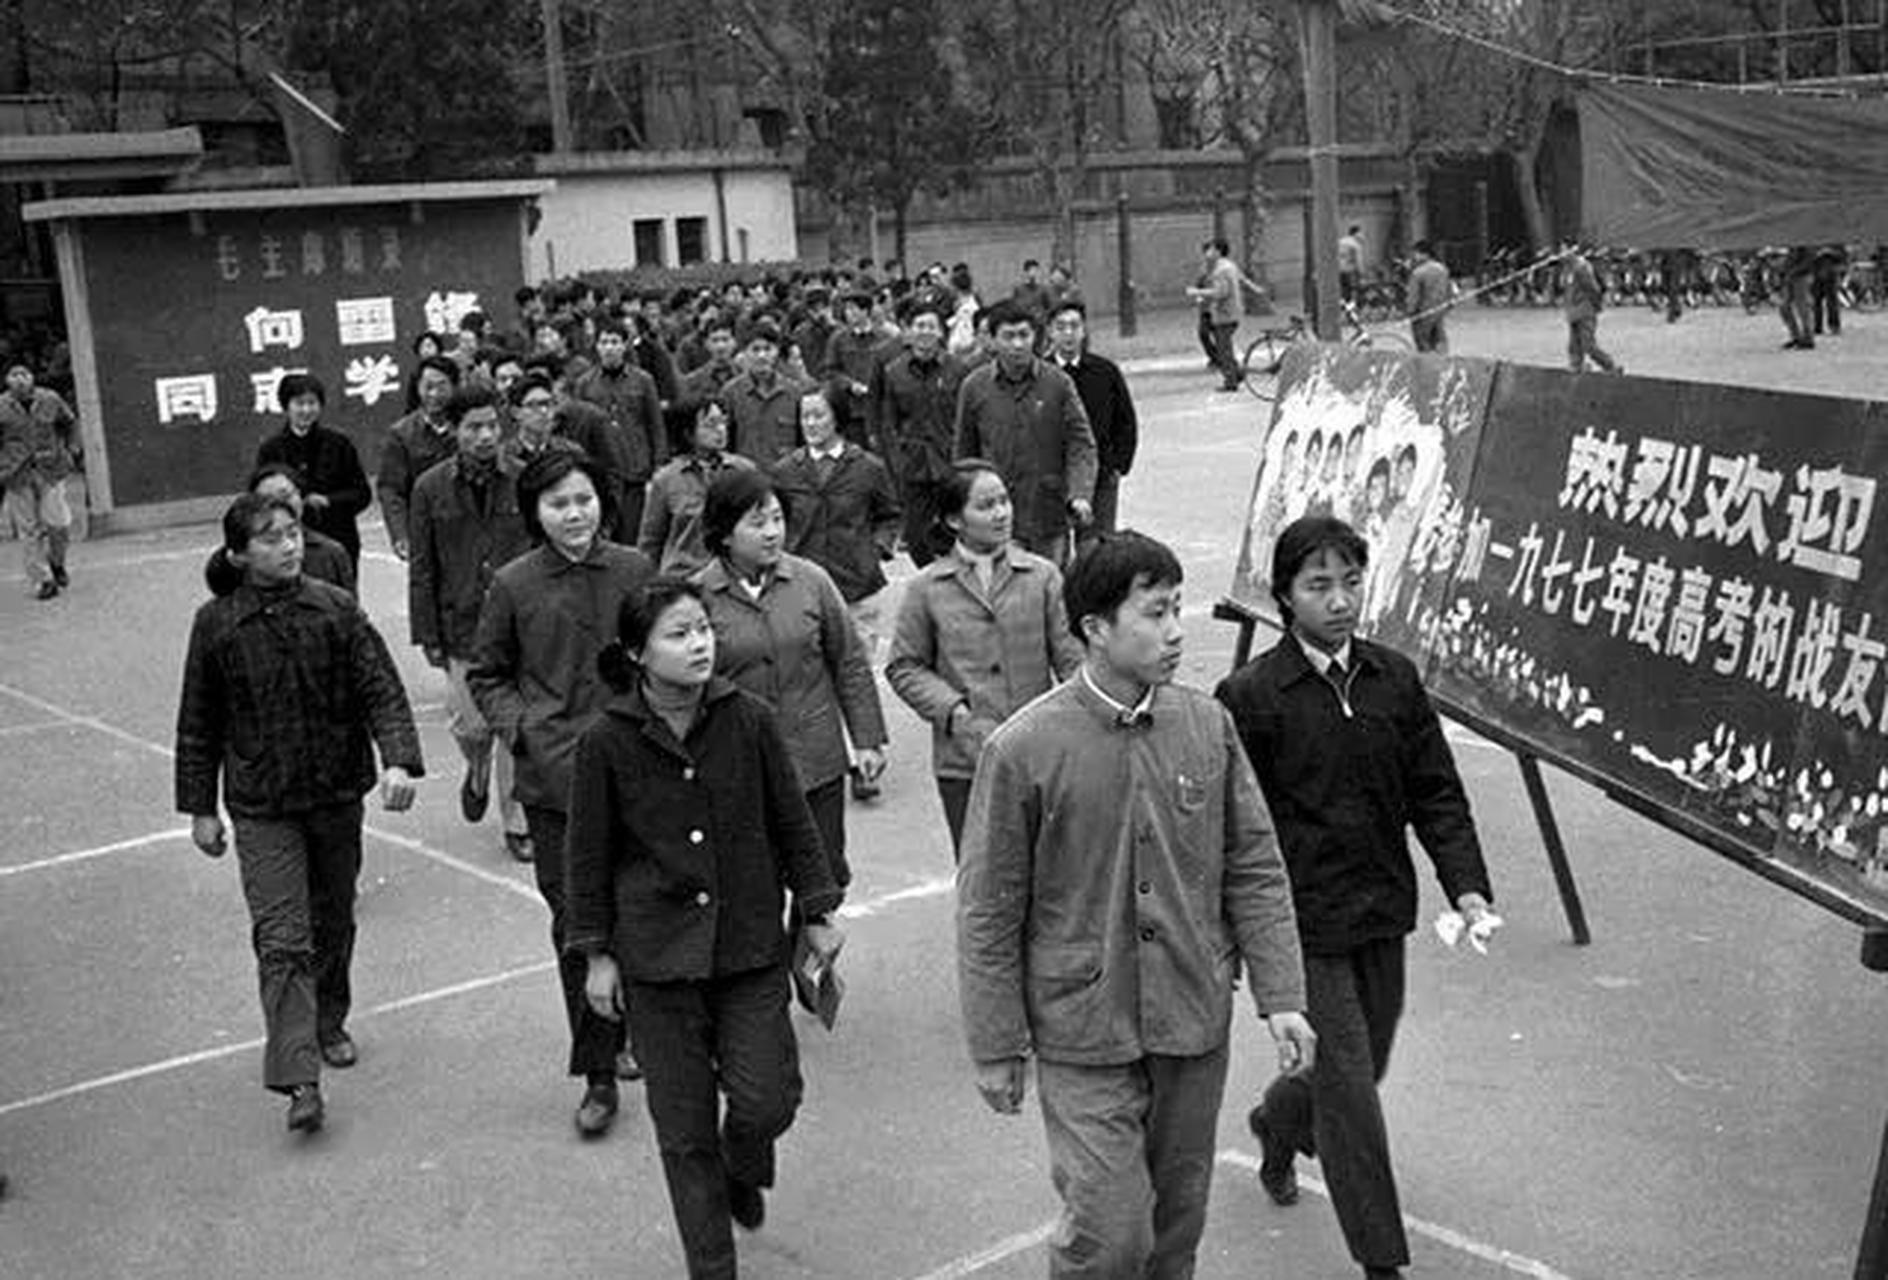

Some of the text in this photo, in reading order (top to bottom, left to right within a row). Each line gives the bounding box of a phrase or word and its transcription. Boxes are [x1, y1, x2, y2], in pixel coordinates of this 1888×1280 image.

[1558, 426, 1877, 581] 热烈欢迎
[1411, 497, 1888, 736] 参加一九七七年度高考的战友
